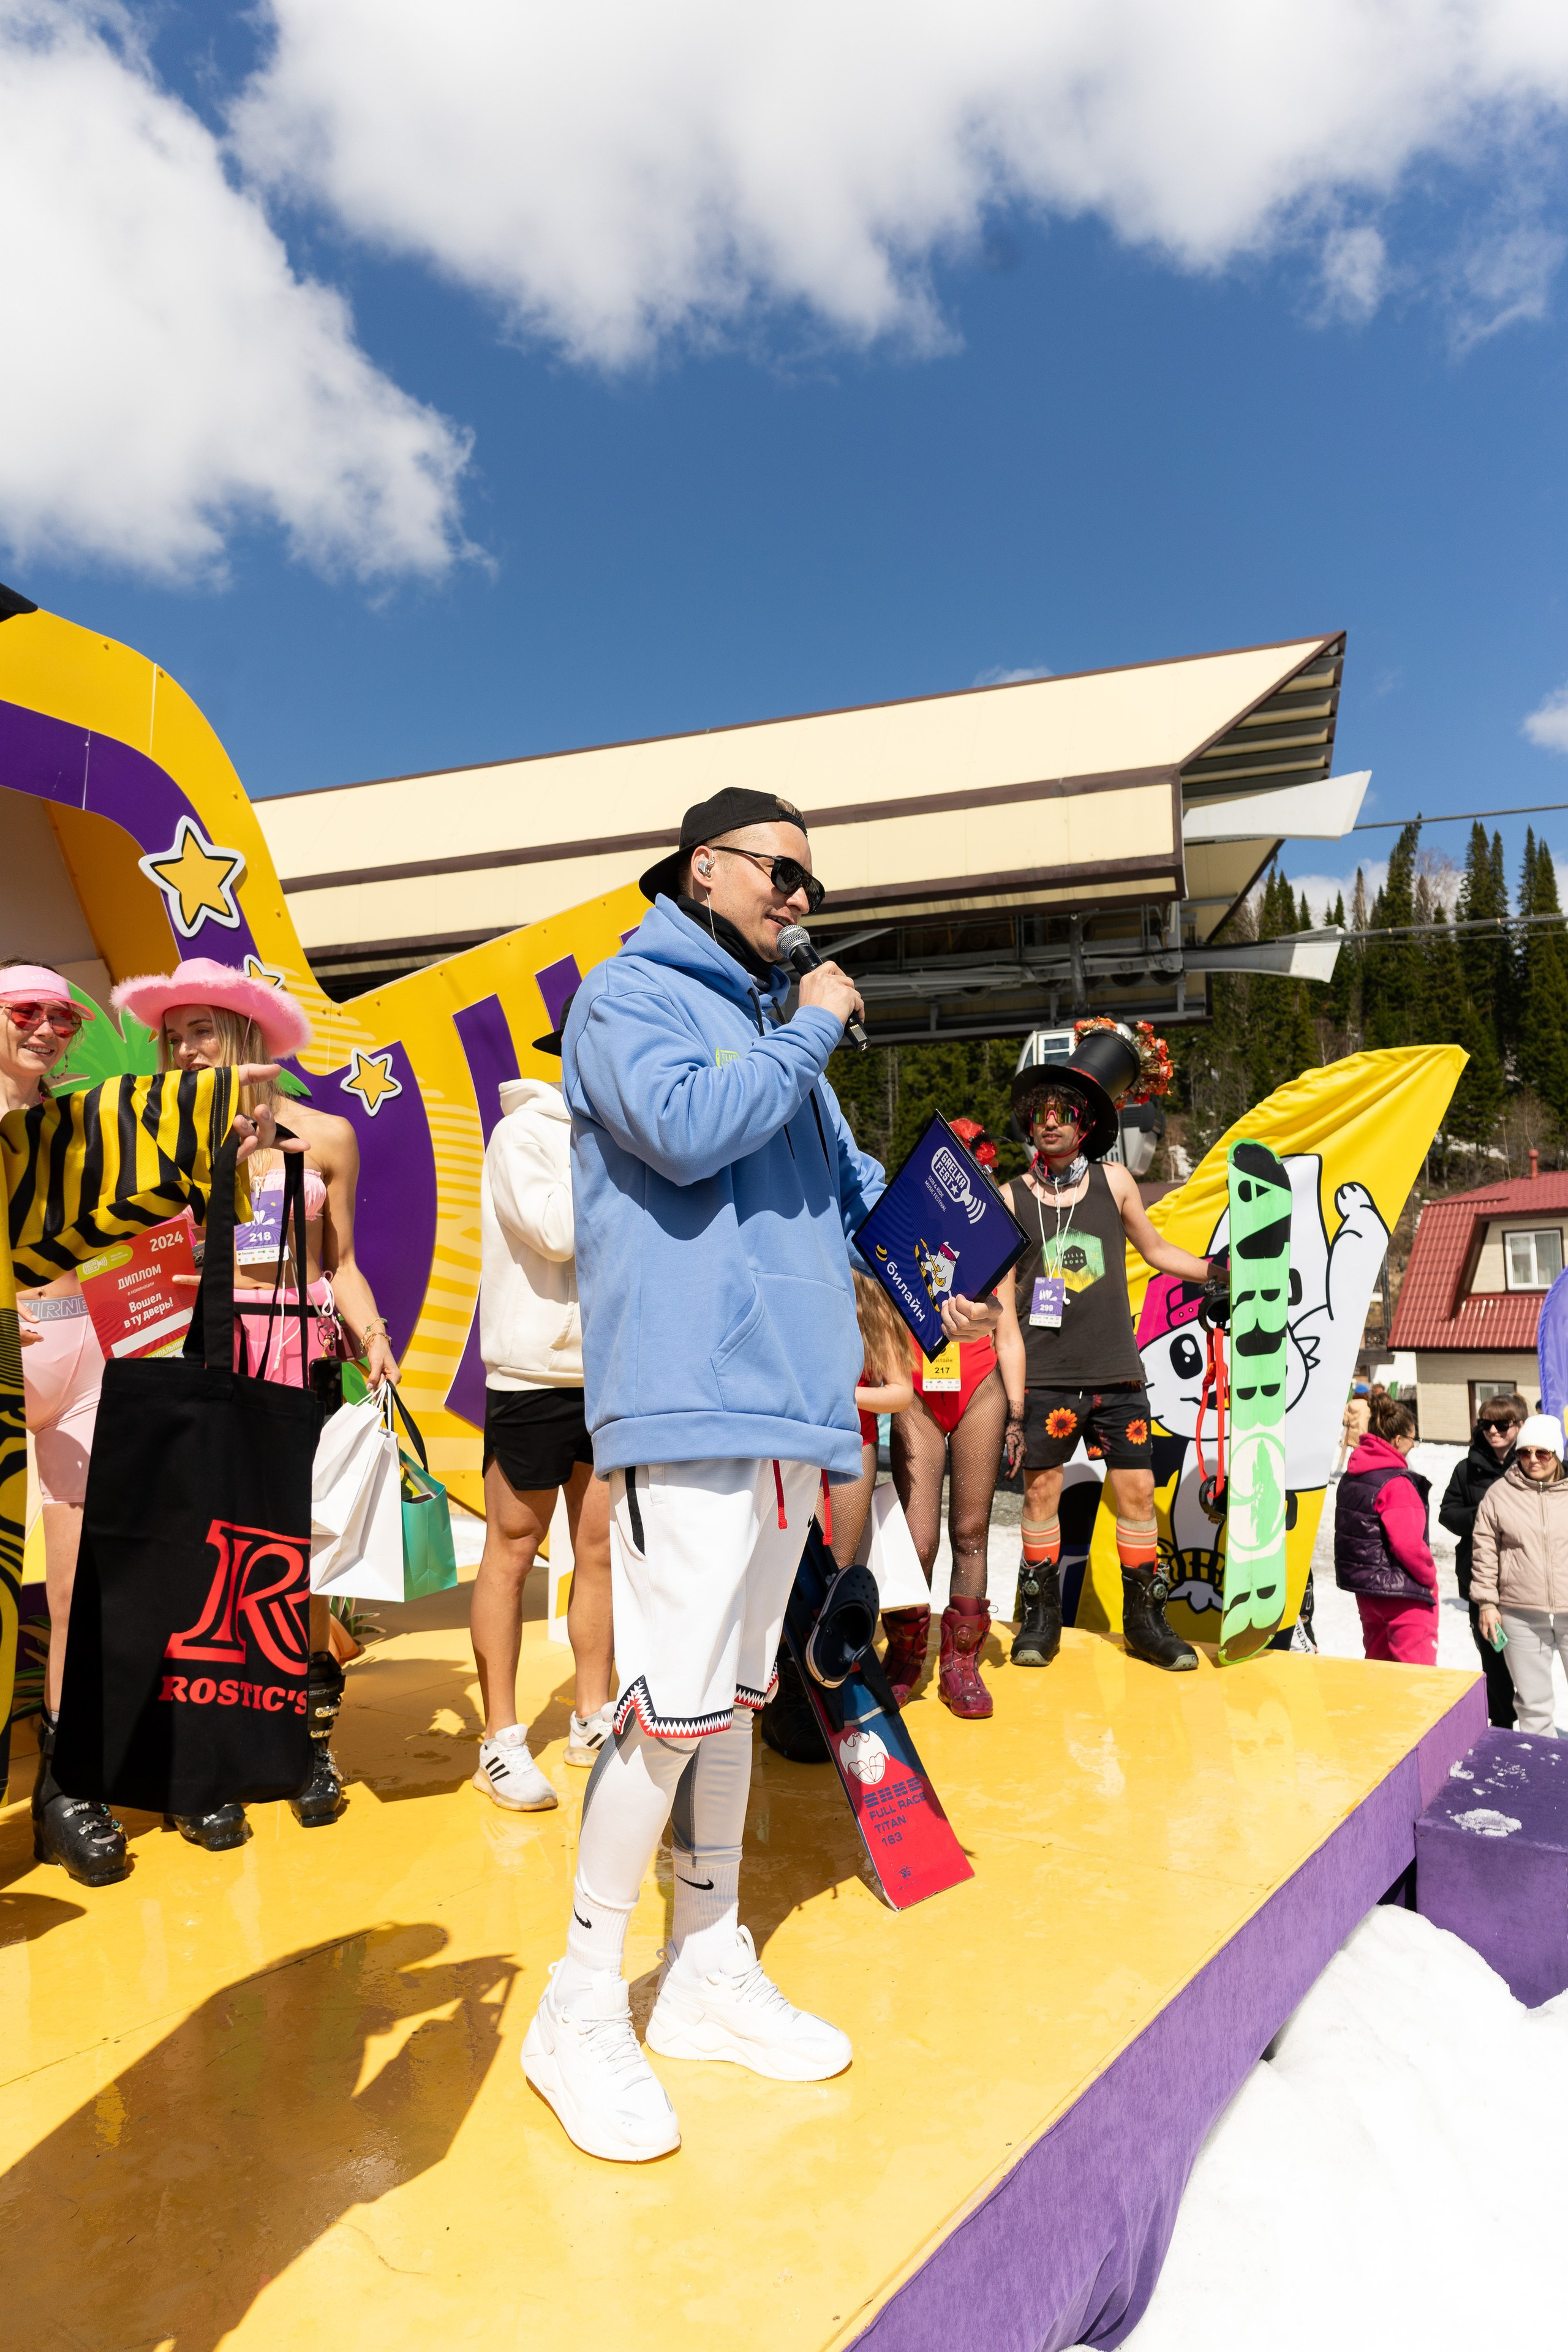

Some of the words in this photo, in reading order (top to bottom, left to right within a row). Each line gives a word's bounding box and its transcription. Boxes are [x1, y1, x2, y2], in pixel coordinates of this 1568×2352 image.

[935, 1161, 954, 1186] FEST
[941, 1153, 967, 1189] GRELKA
[924, 1180, 935, 1195] MUSIC
[933, 1193, 947, 1212] FESTIVAL
[936, 1186, 944, 1198] RIDE
[149, 1231, 184, 1253] 2024
[249, 1231, 271, 1243] 218
[118, 1264, 162, 1290] ДИПЛОМ
[130, 1281, 155, 1295] номинации
[129, 1292, 162, 1314] Вошел
[886, 1261, 926, 1322] билайн
[124, 1320, 132, 1329] в
[130, 1314, 142, 1327] ту
[143, 1297, 174, 1321] дверь!
[158, 1676, 307, 1714] ROSTIC'S
[869, 1804, 897, 1821] FULL
[897, 1791, 927, 1810] RACE
[874, 1814, 907, 1834] TITAN
[881, 1831, 903, 1847] 163
